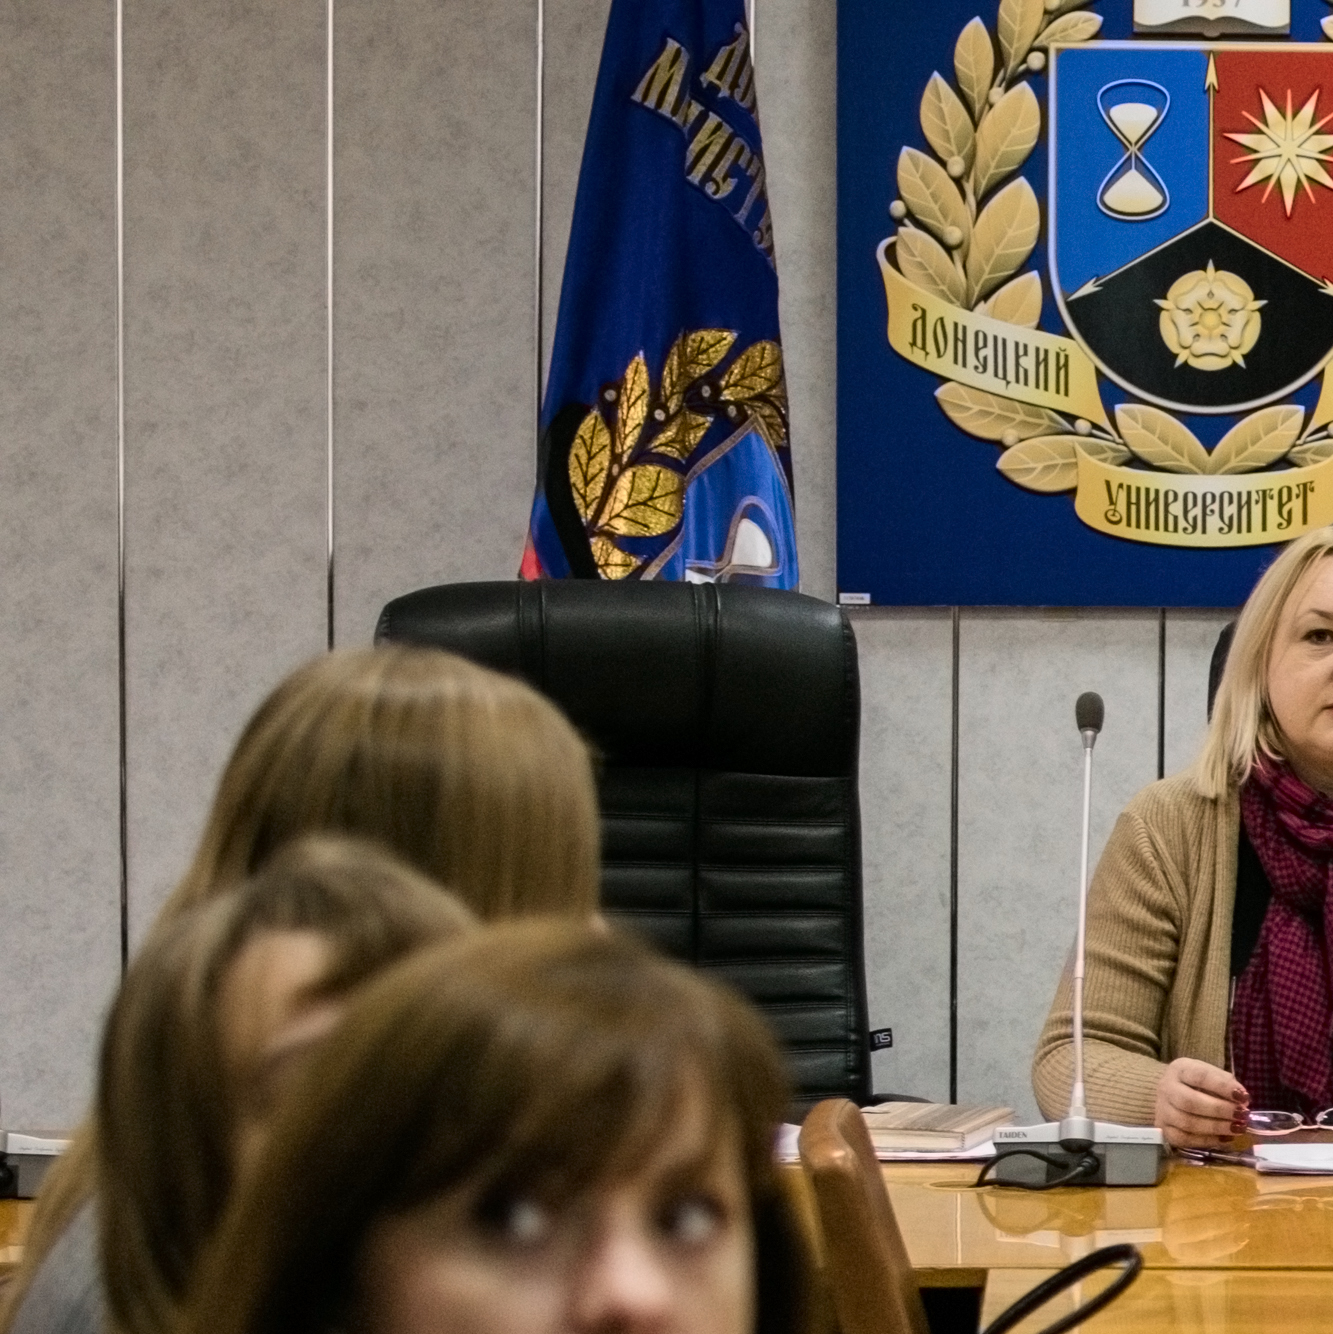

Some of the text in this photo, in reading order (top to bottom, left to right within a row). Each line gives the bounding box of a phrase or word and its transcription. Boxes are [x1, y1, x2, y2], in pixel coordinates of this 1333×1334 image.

[908, 303, 1070, 397] ДОНЕЦКИЙ
[1104, 478, 1315, 535] УНИВЕРСИТЕТ
[998, 1131, 1028, 1139] TAIDEN
